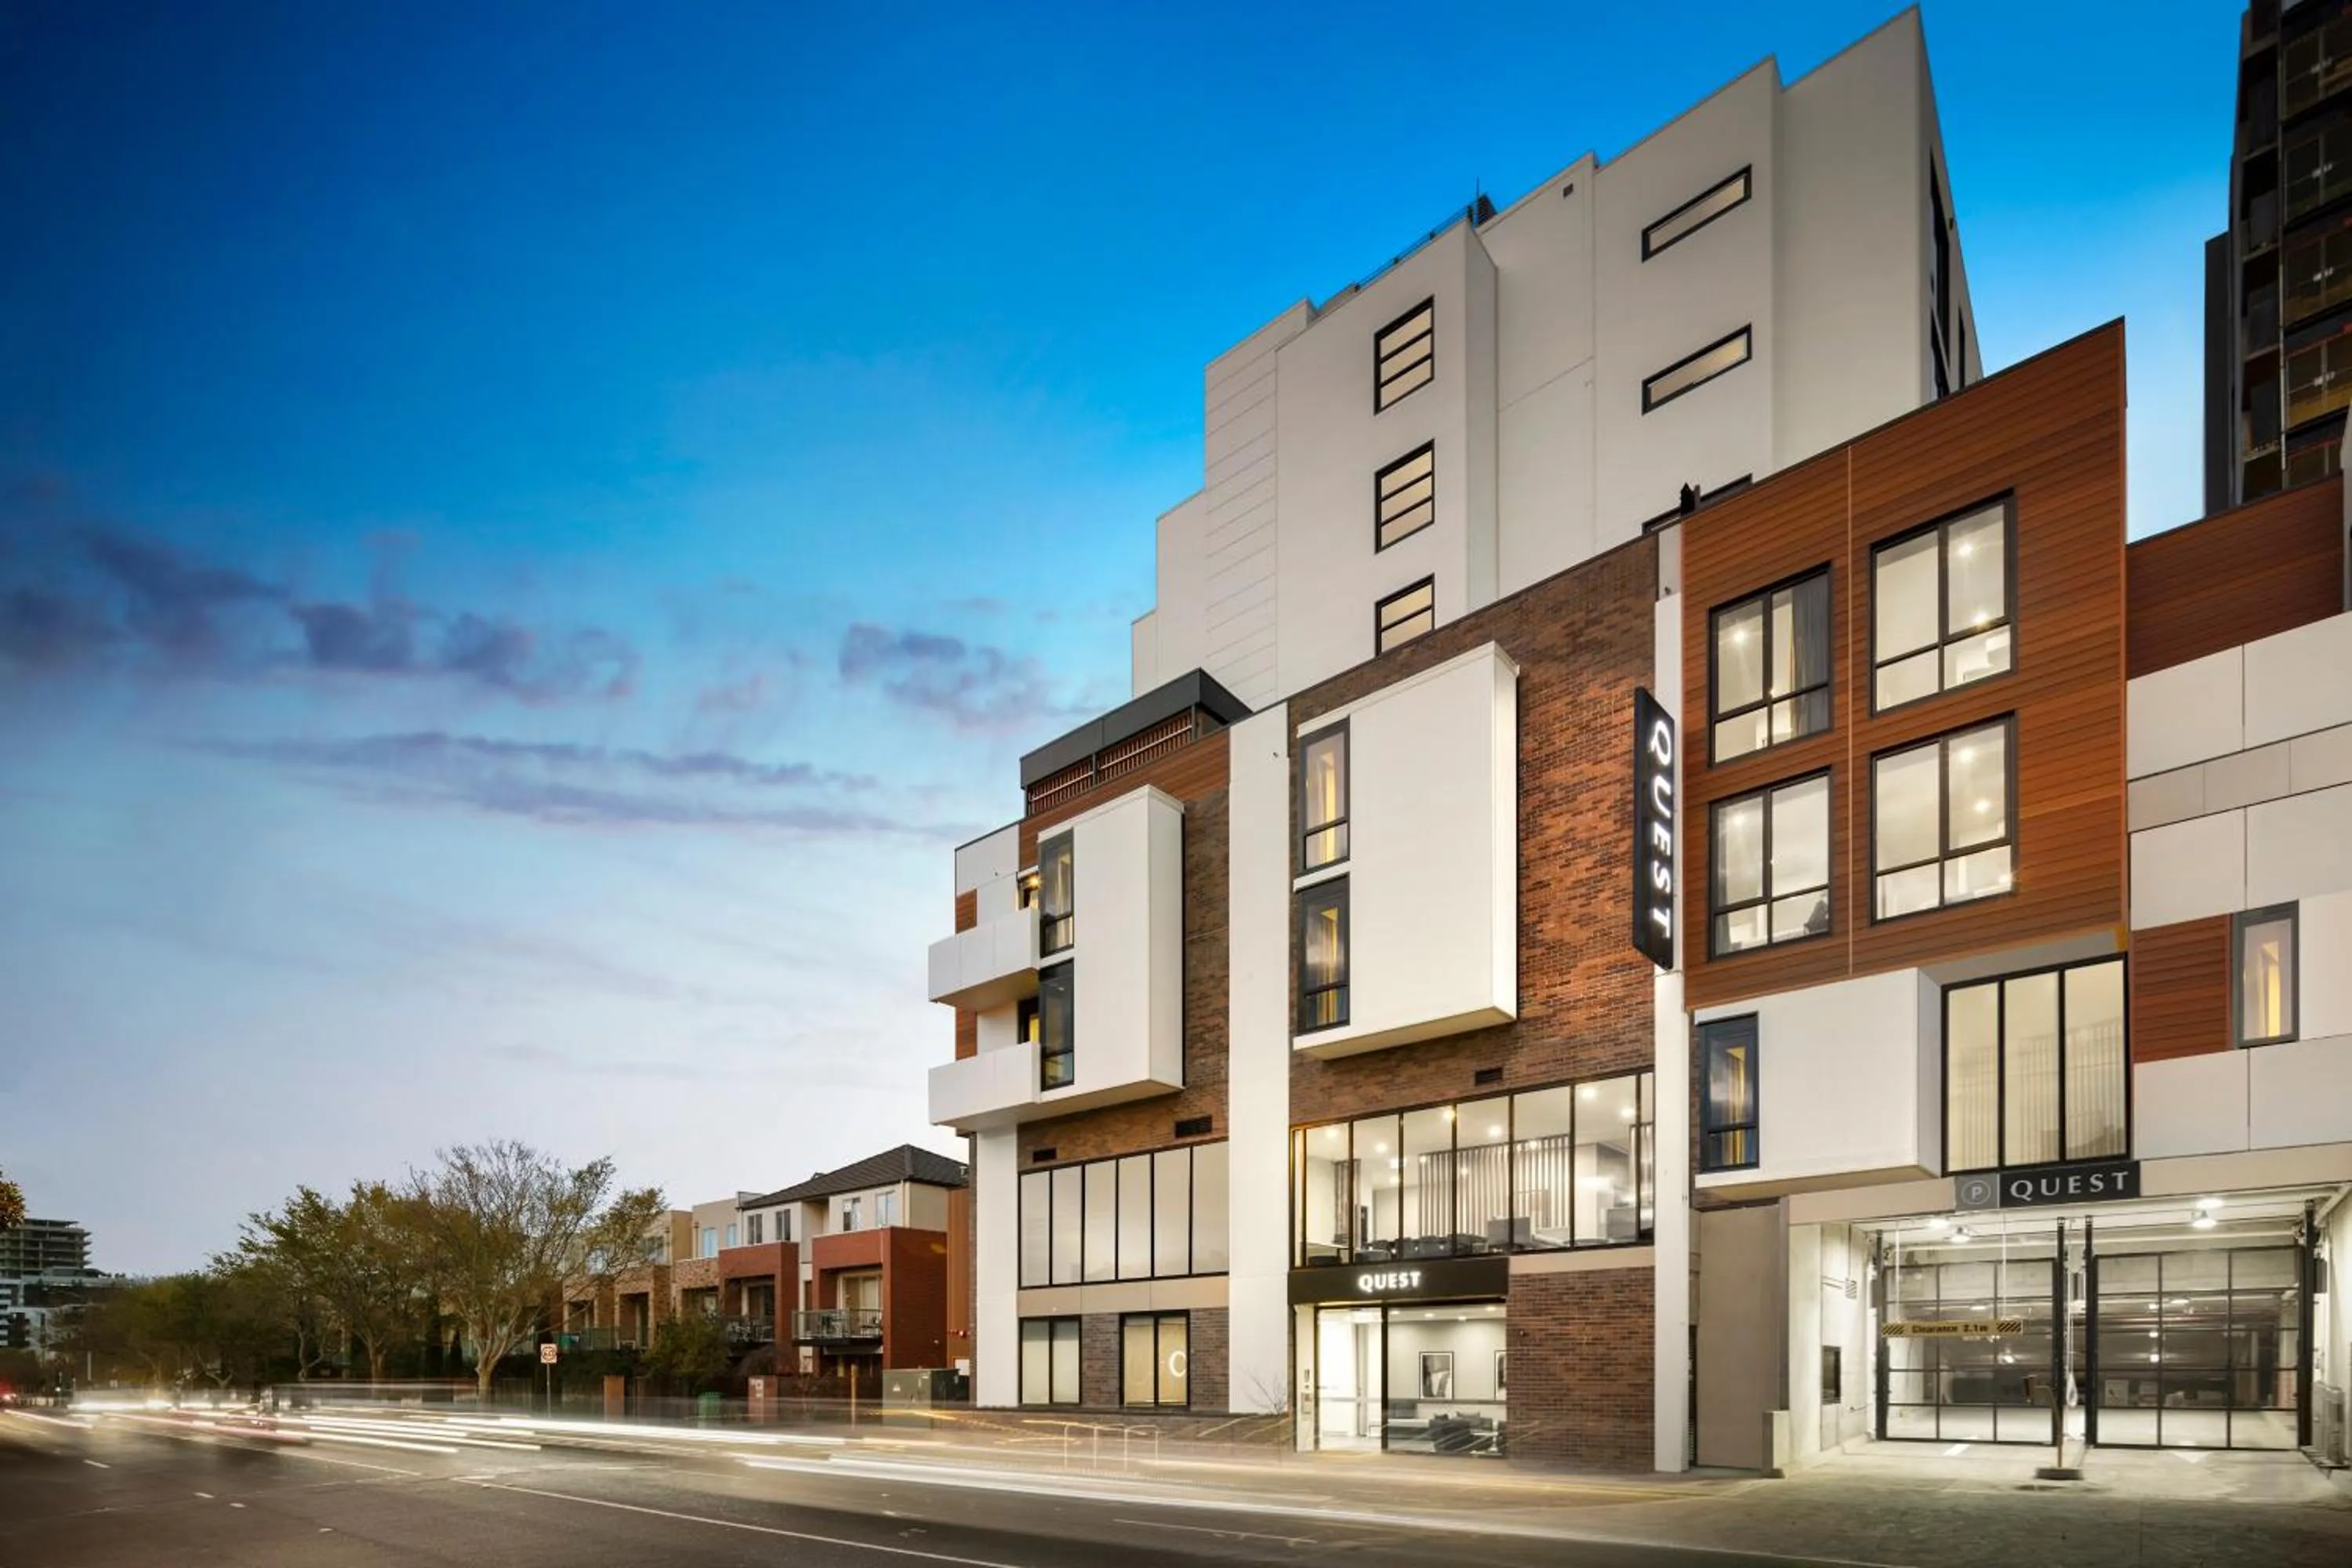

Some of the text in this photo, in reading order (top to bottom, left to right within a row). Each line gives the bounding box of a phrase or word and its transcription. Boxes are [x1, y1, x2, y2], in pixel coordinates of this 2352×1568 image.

[1650, 719, 1672, 939] QUEST
[1971, 1185, 1983, 1200] P
[2009, 1171, 2129, 1201] QUEST
[1357, 1271, 1422, 1293] QUEST
